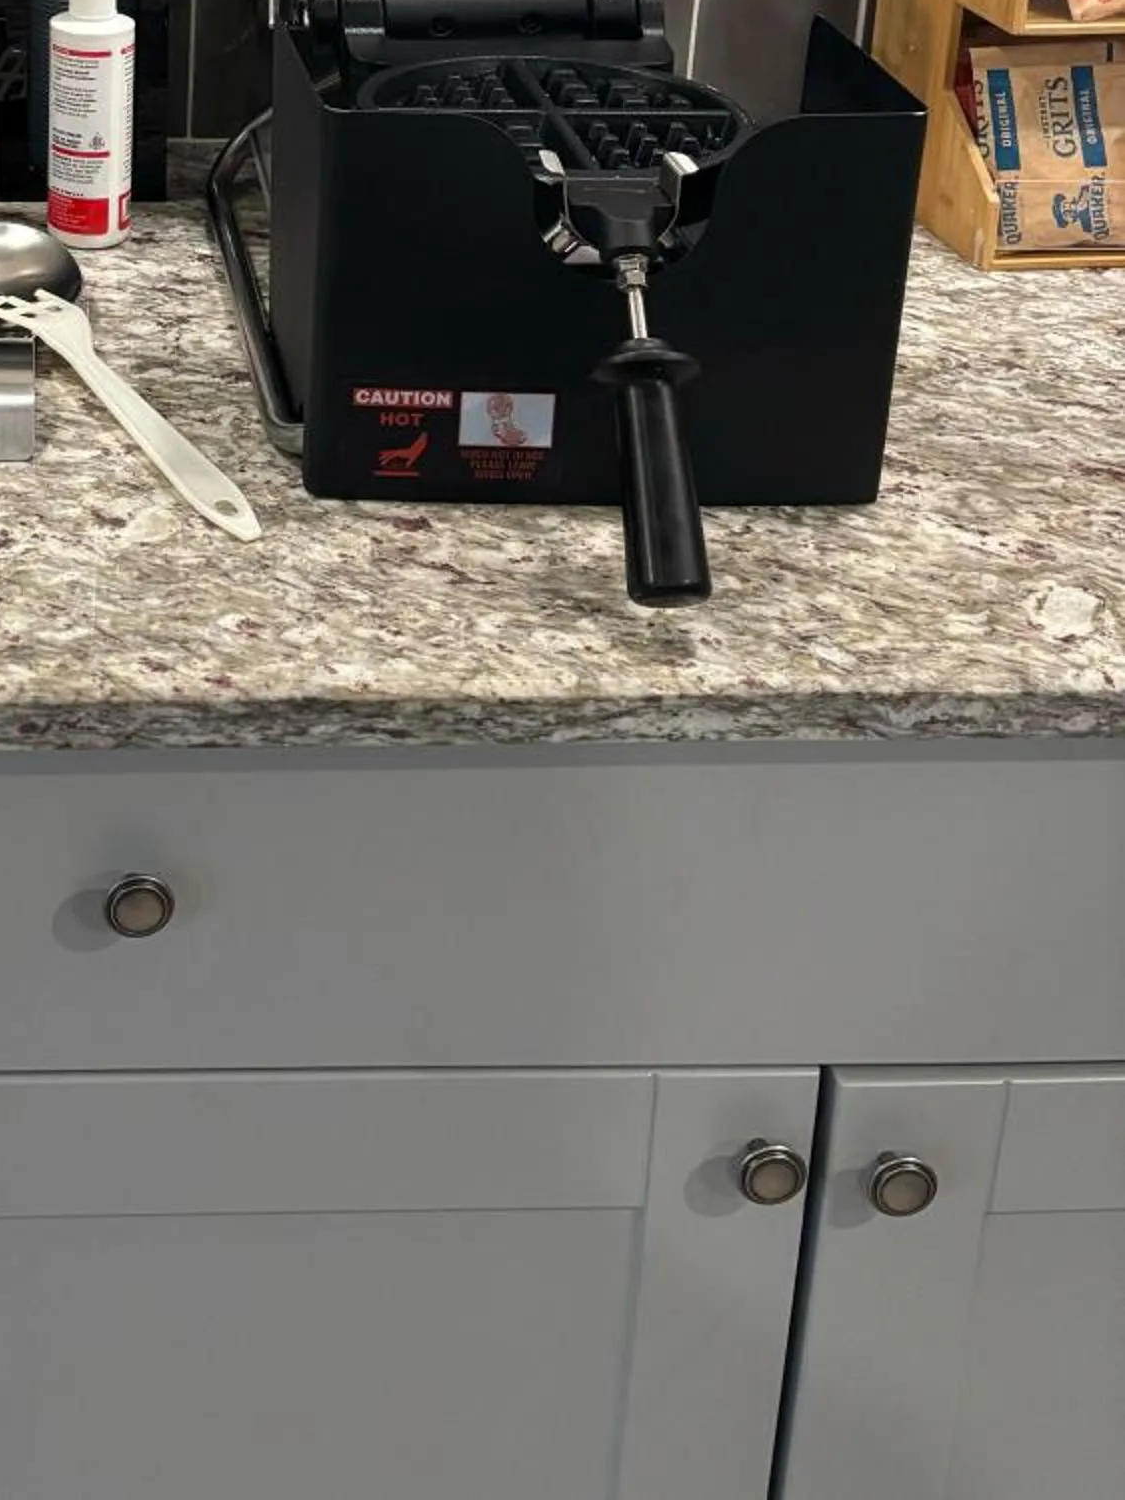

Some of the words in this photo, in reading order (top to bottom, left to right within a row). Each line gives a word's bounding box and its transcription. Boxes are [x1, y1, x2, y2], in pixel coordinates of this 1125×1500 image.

[994, 91, 1012, 148] ORIGINAL
[1046, 76, 1077, 158] GRITS
[1079, 90, 1097, 145] ORIGINAL
[1001, 181, 1022, 245] QUAKER
[1089, 176, 1110, 241] QUAKER
[354, 390, 452, 407] CAUTION
[379, 412, 424, 427] HOT
